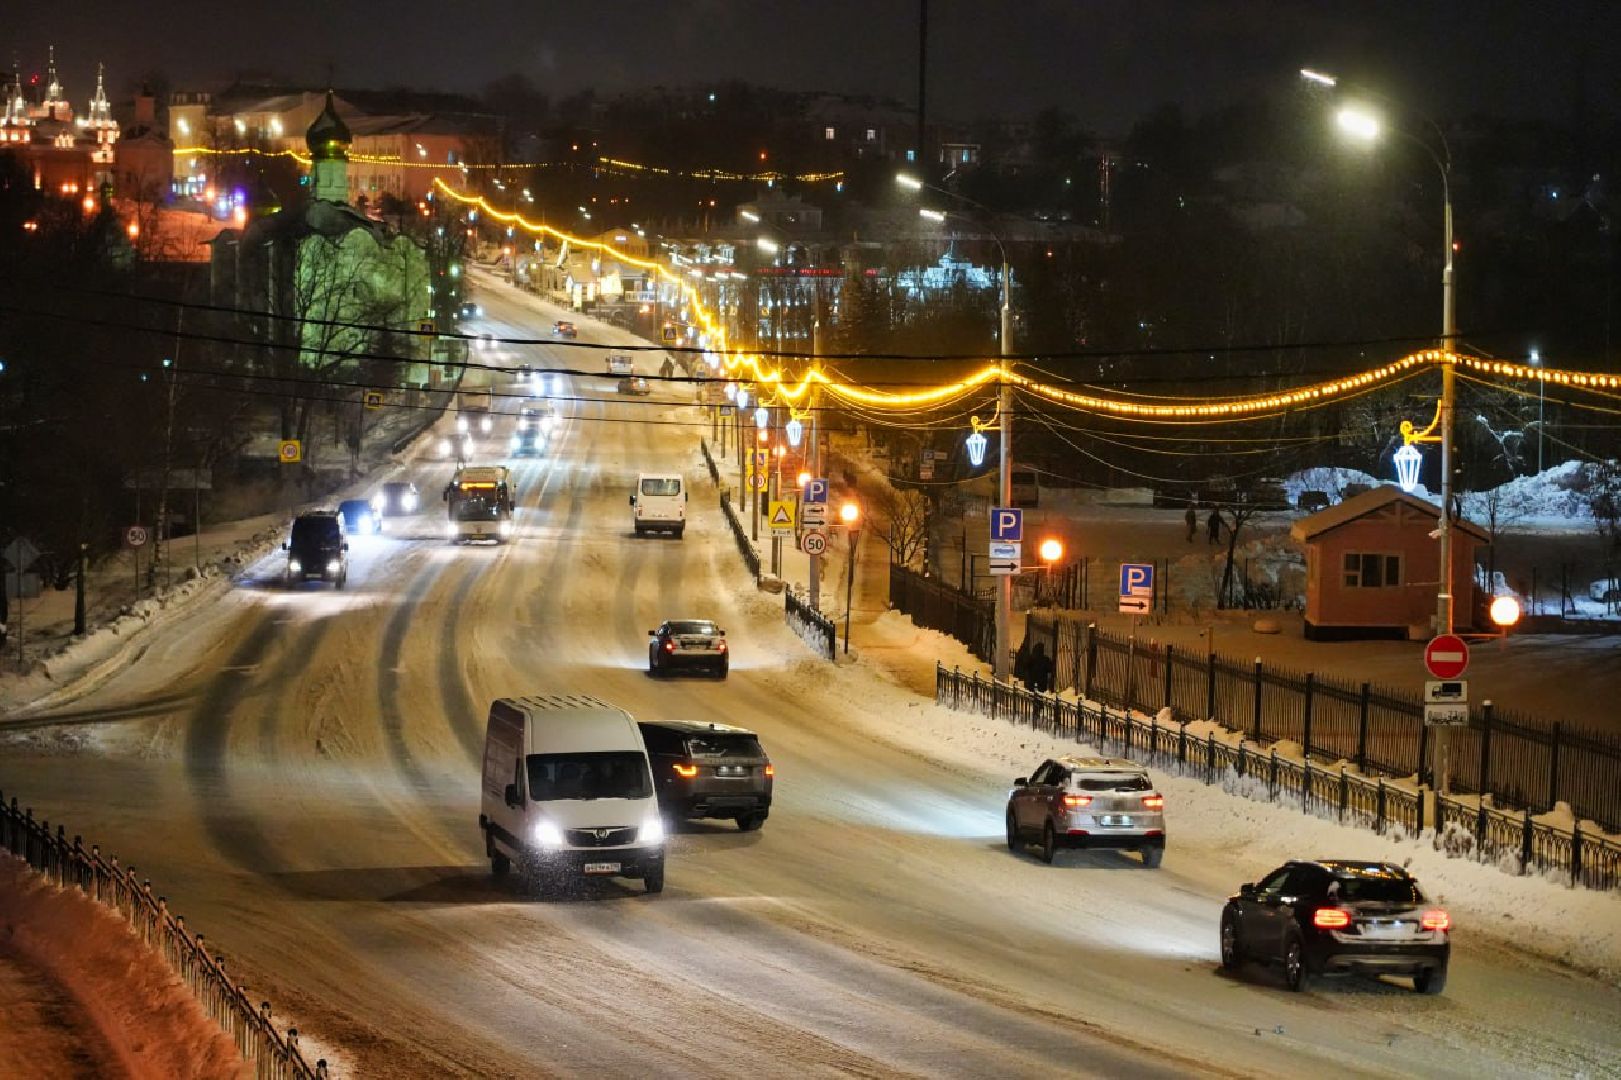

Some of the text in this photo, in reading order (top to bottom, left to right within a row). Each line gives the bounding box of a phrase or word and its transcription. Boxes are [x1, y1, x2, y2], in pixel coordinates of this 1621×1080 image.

[810, 481, 824, 502] P
[998, 511, 1016, 537] P
[130, 530, 145, 541] 50
[808, 538, 823, 550] 50
[1127, 568, 1145, 592] P
